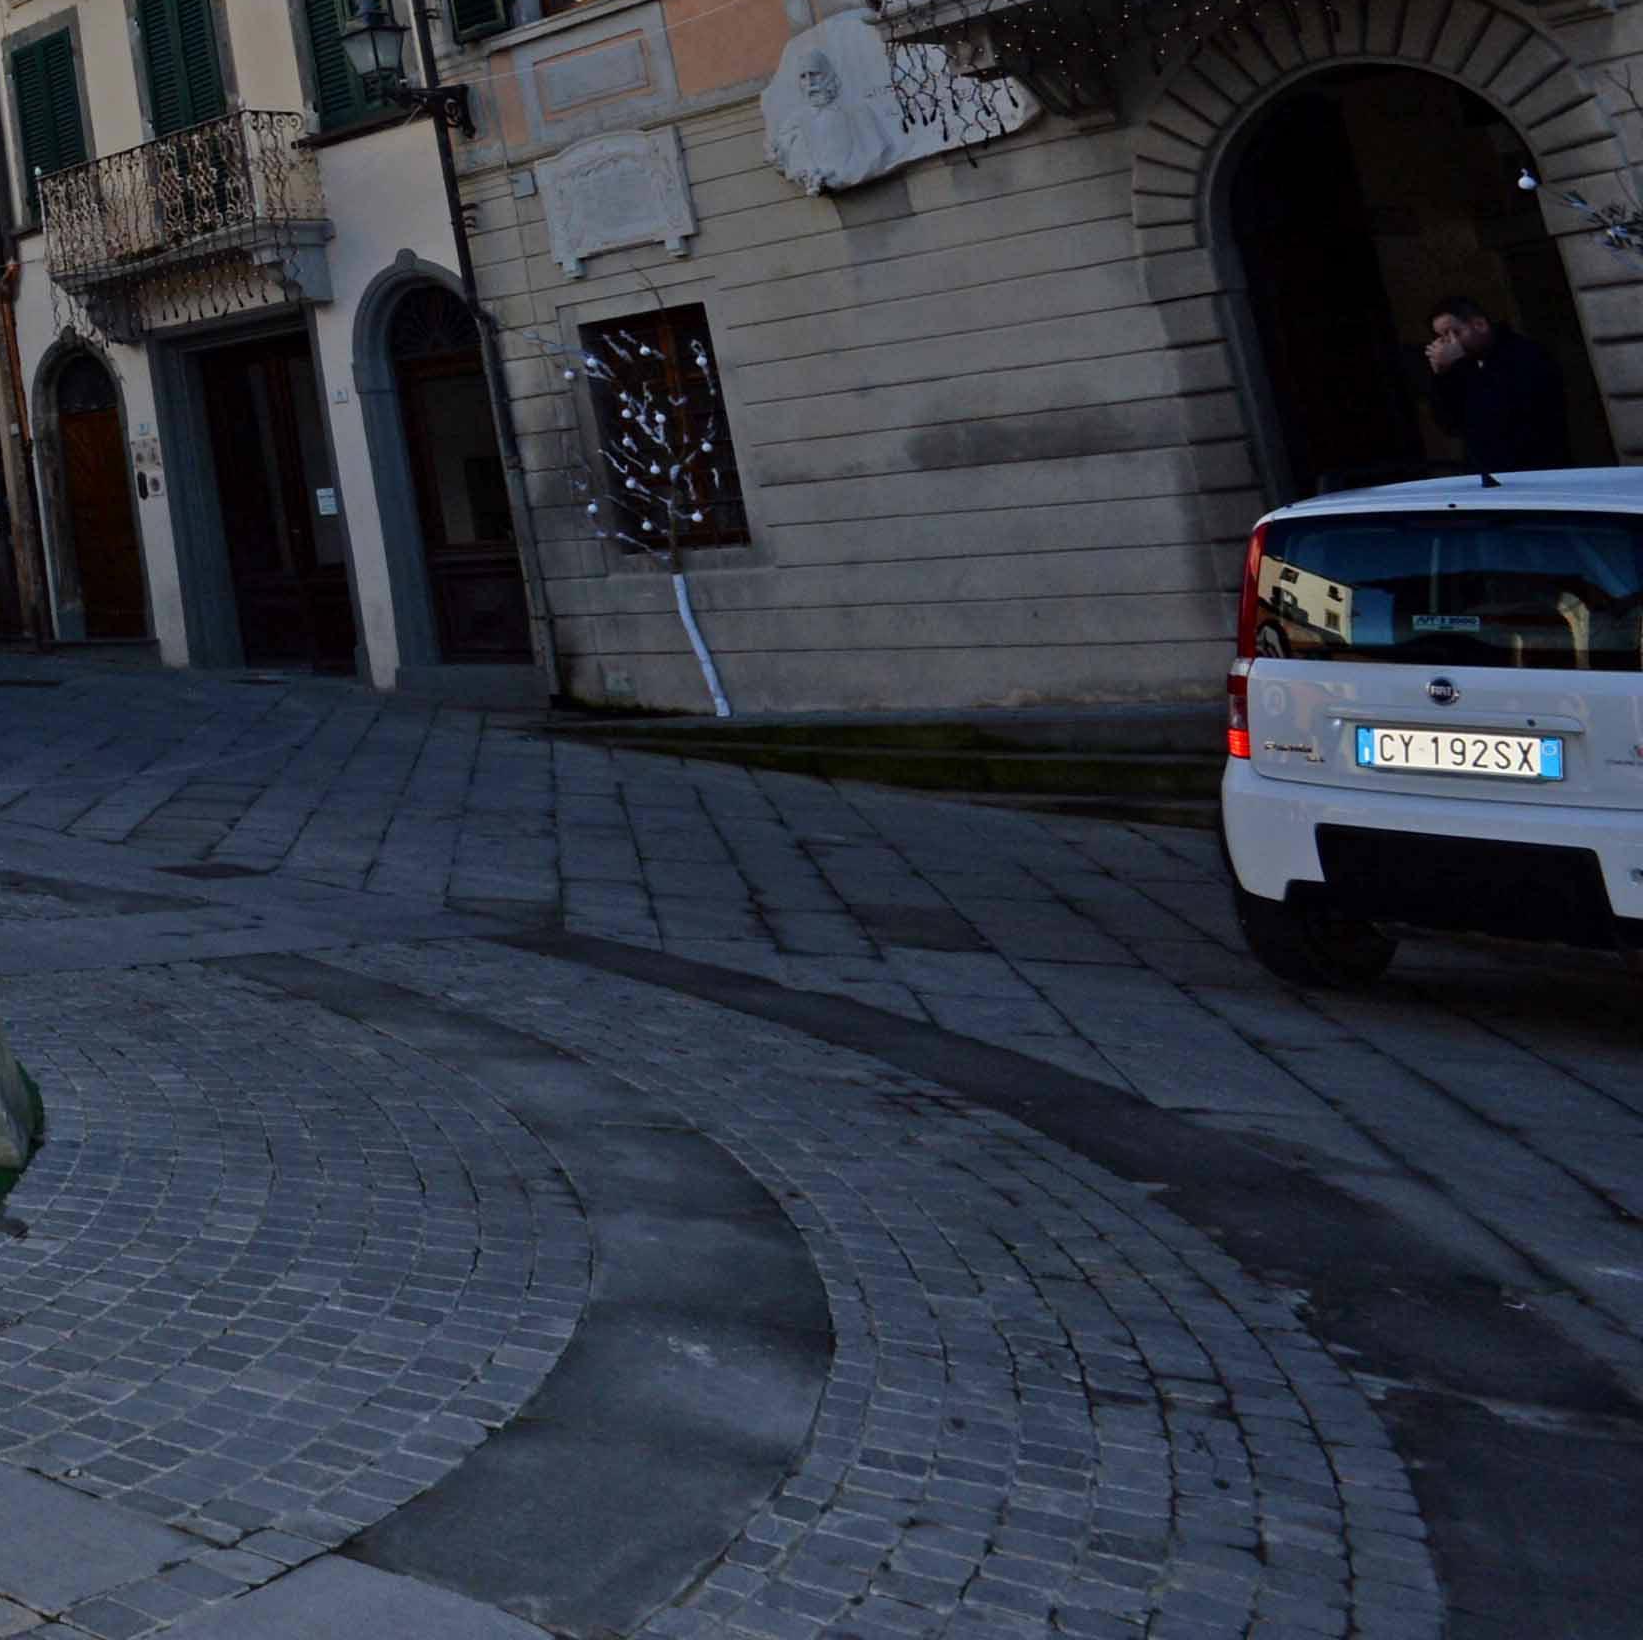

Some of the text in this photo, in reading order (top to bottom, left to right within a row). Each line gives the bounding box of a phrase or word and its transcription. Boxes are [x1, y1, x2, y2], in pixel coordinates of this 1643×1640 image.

[1430, 684, 1453, 697] FIAT
[1380, 734, 1534, 772] CY 192SX
